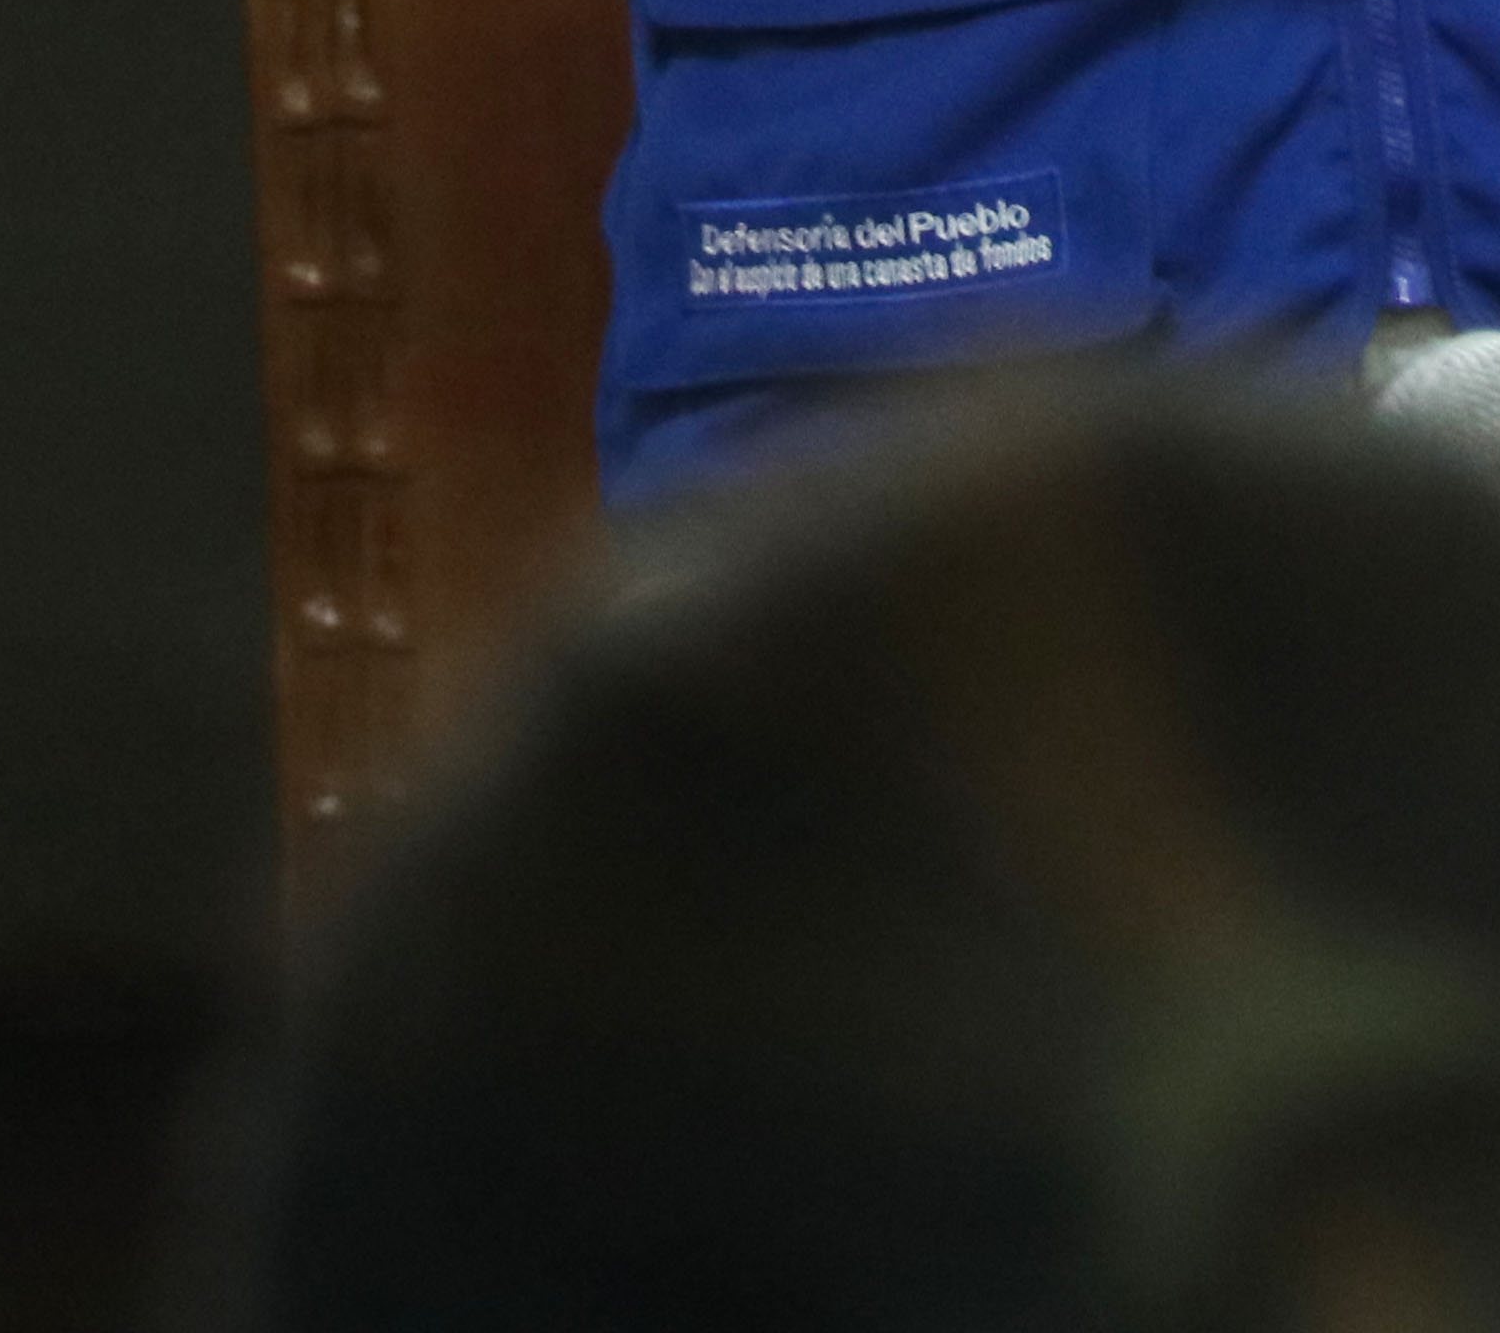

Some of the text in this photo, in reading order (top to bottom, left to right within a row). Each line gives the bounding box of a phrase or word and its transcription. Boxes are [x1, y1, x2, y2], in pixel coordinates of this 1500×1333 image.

[855, 216, 906, 249] del
[908, 199, 1030, 244] Pueblo
[801, 255, 825, 291] de
[825, 261, 861, 290] una
[863, 251, 949, 287] canasta
[950, 242, 978, 277] de
[979, 231, 1052, 272] fondos
